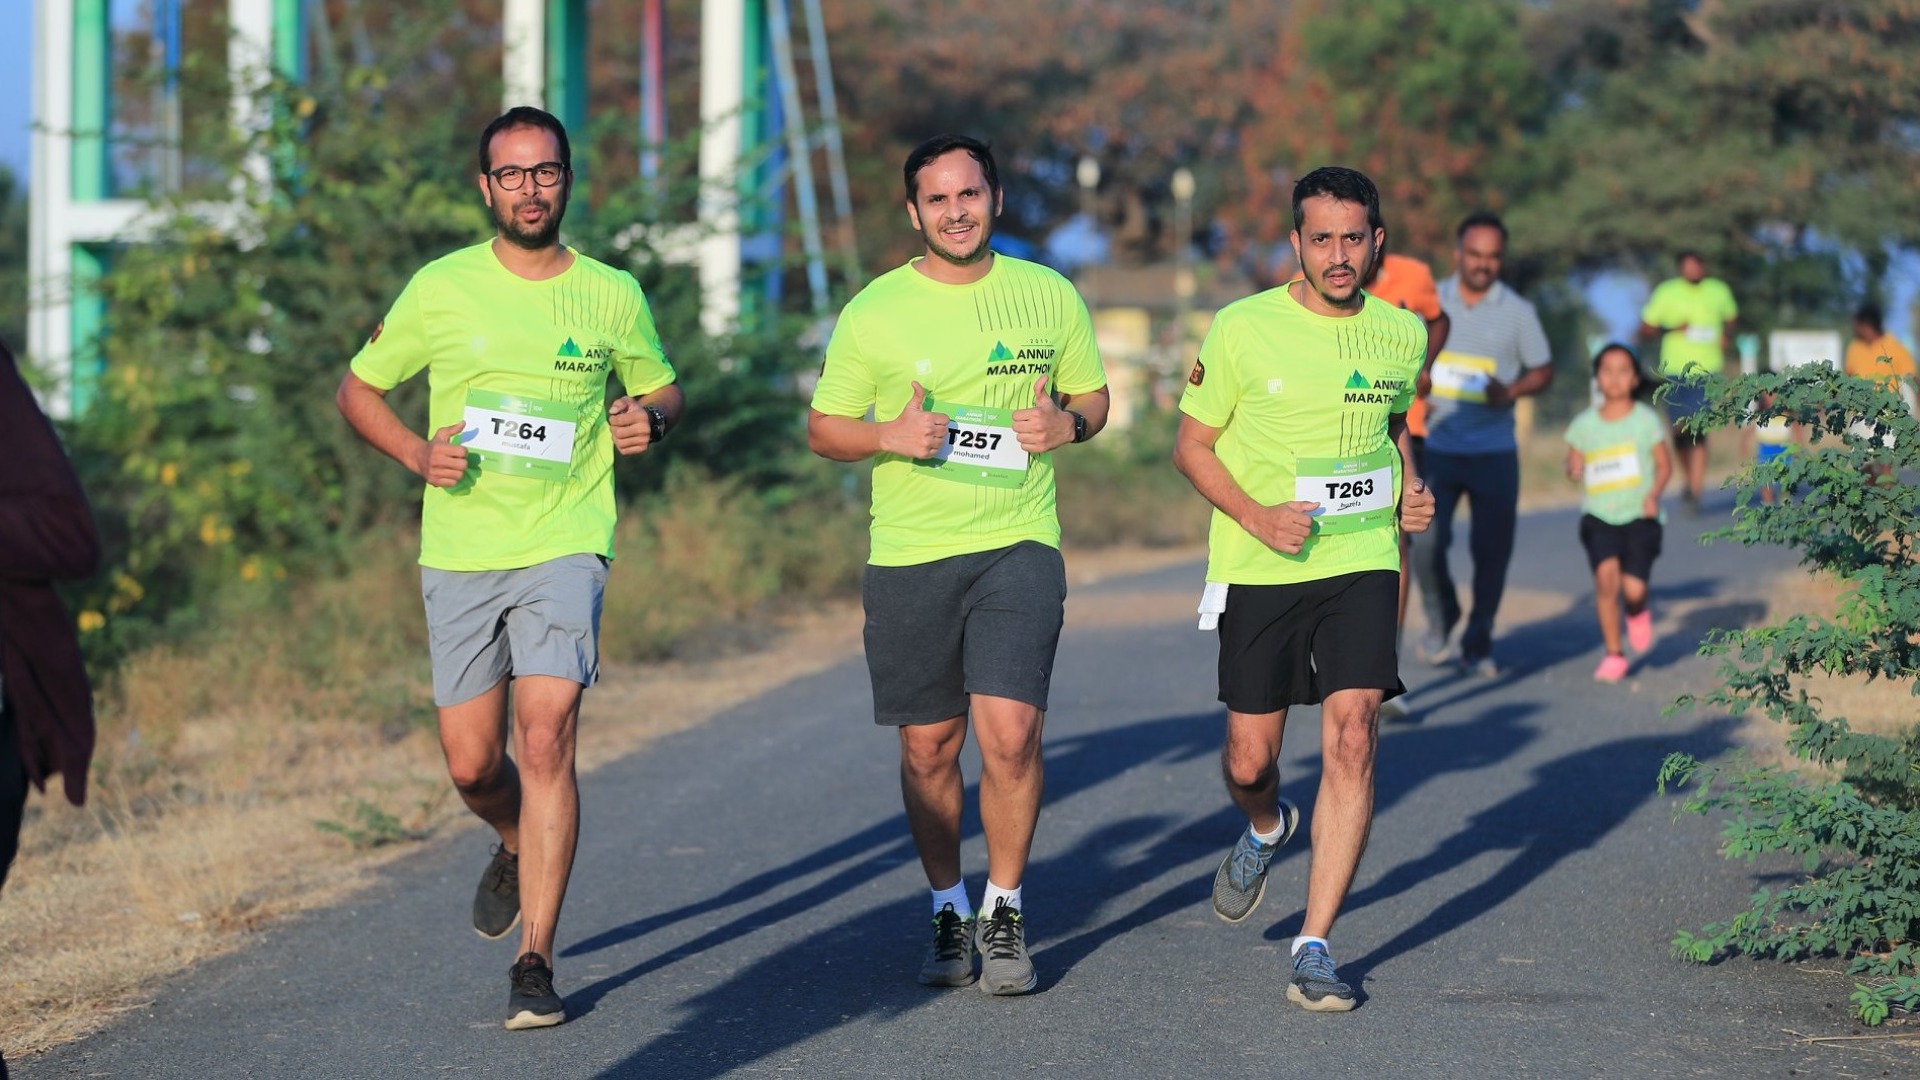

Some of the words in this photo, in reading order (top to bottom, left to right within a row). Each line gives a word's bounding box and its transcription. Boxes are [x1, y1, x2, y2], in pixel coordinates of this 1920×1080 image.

[1016, 348, 1055, 360] ANNUR
[986, 363, 1052, 376] MARATHON
[491, 417, 546, 442] T264
[501, 440, 531, 450] mustafa
[948, 428, 1002, 451] T257
[953, 450, 990, 460] mohamed
[1325, 478, 1374, 500] T263
